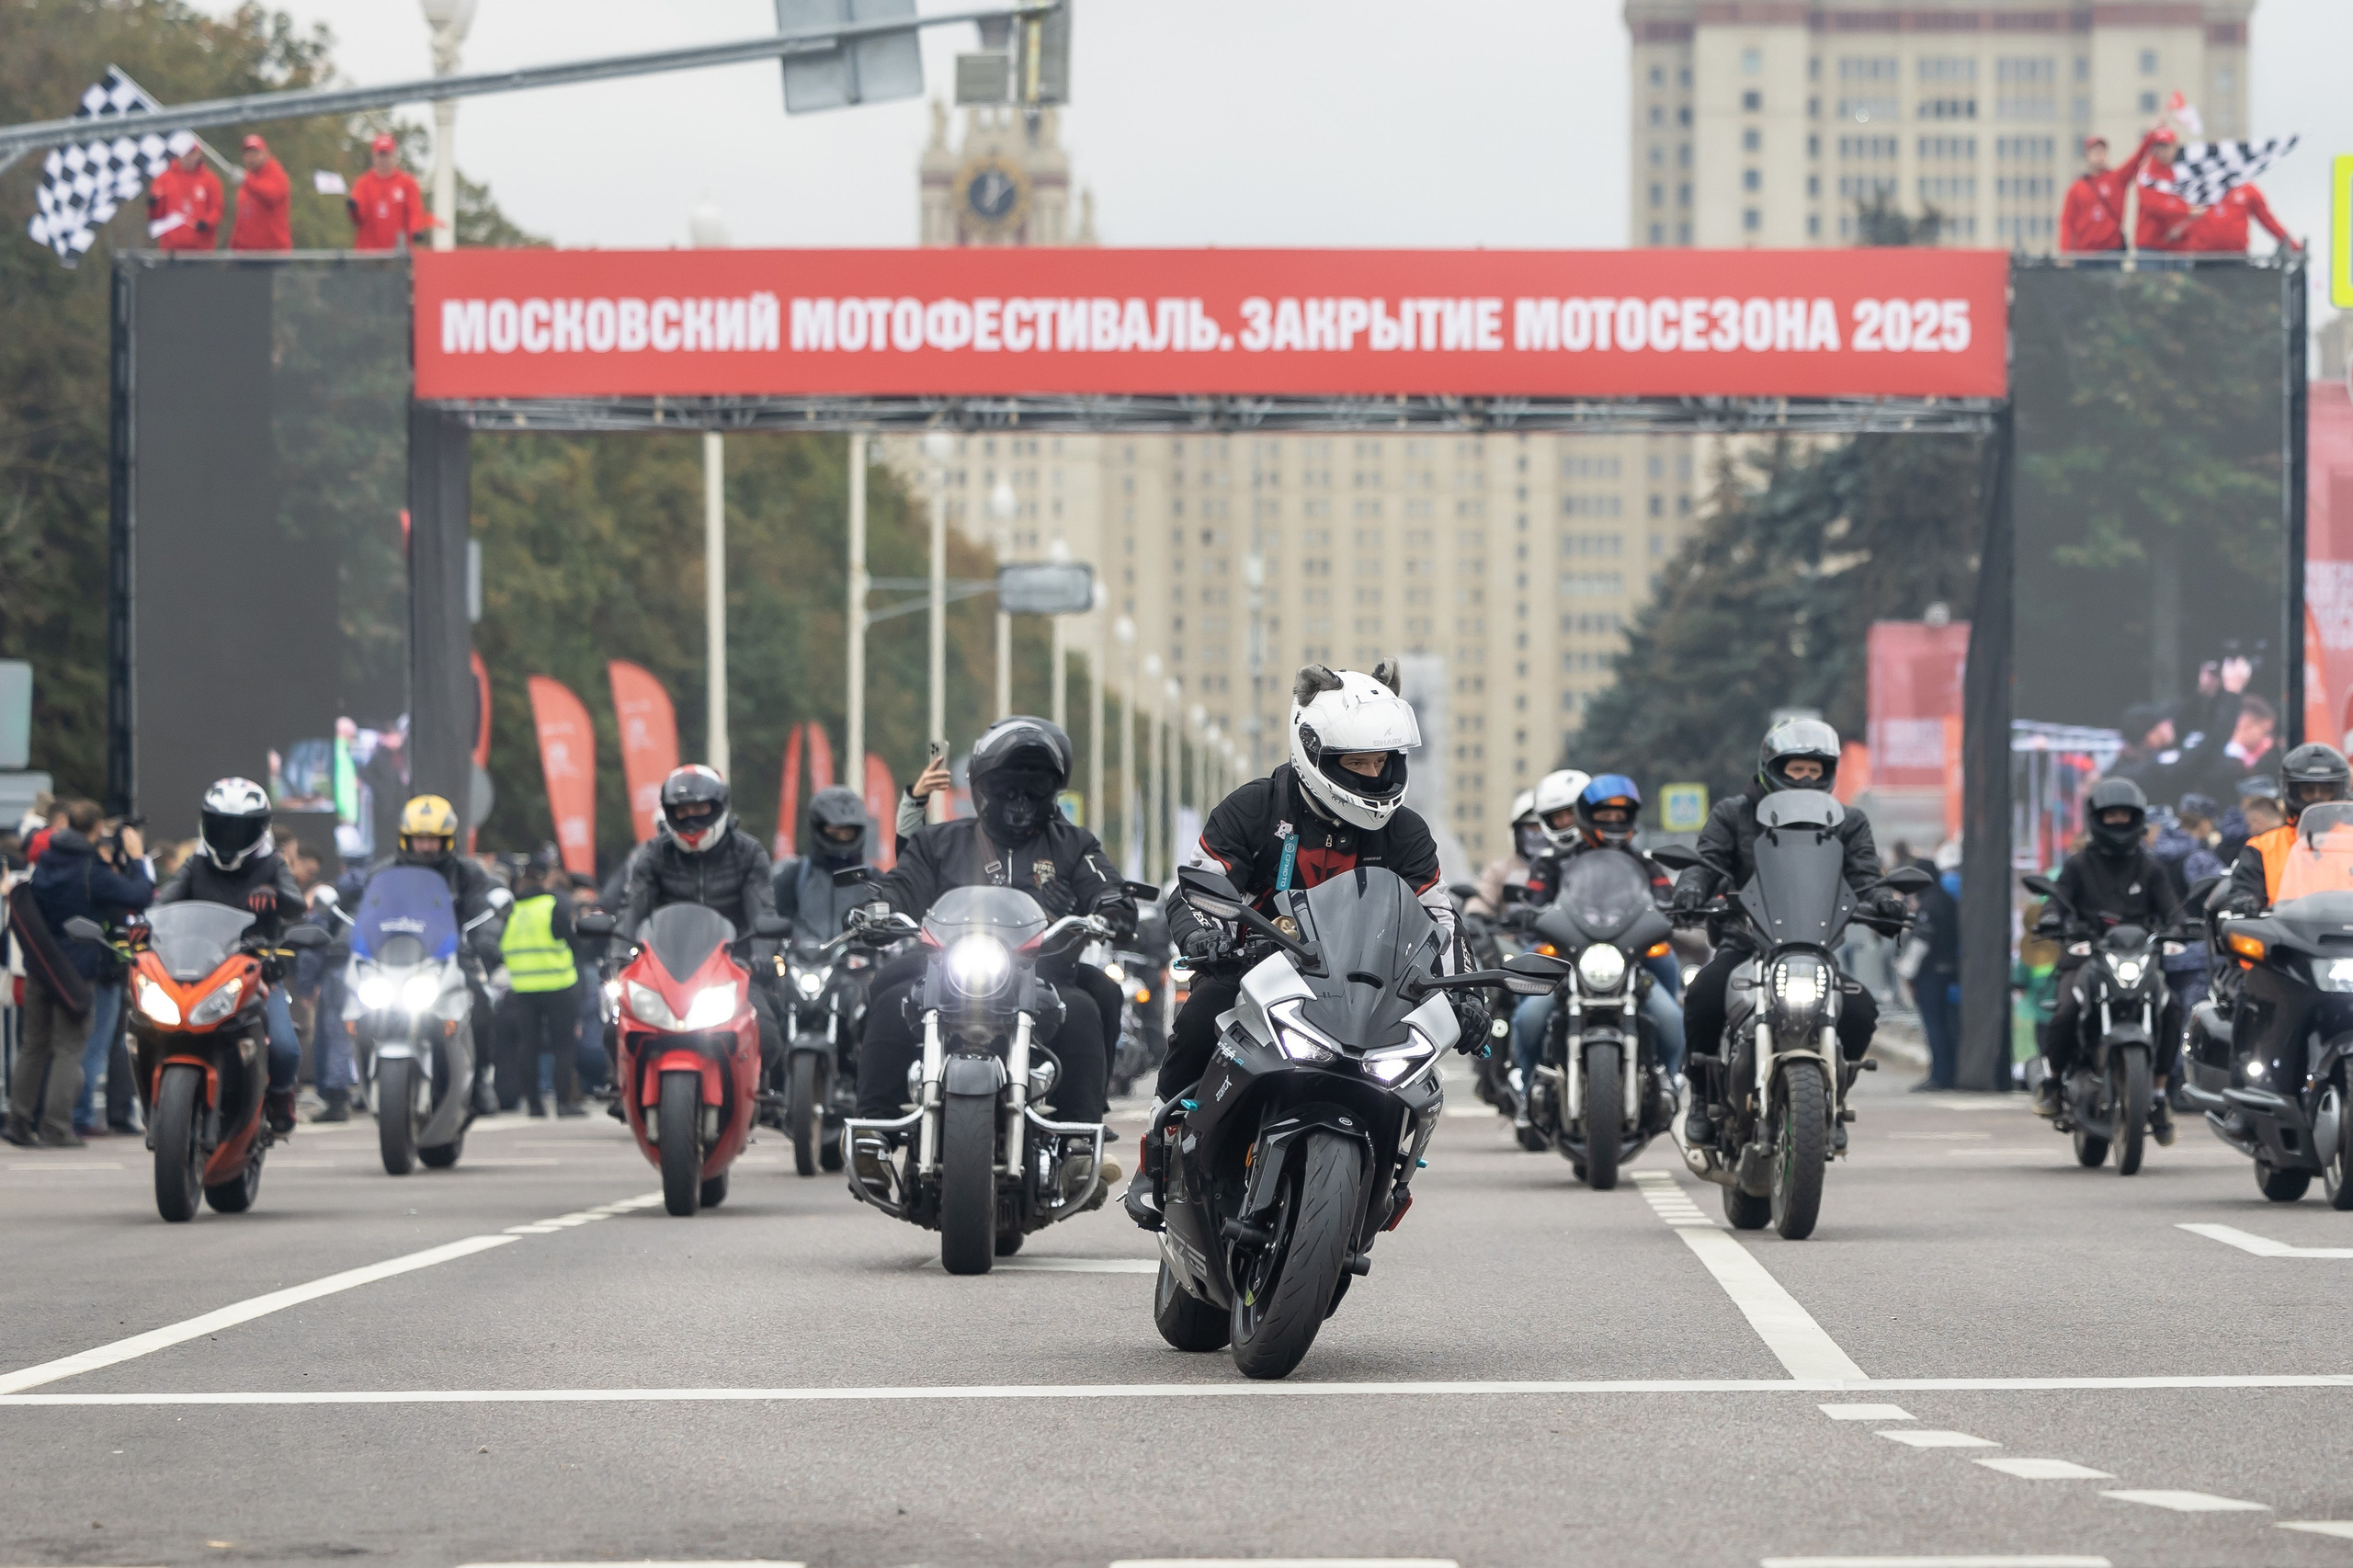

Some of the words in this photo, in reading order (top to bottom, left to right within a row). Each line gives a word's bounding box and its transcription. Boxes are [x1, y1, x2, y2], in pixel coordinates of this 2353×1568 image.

[441, 291, 780, 354] МОСКОВСКИЙ
[790, 297, 1234, 352] МОТОФЕСТИВАЛЬ.
[1239, 297, 1504, 352] ЗАКРЫТИЕ
[1513, 297, 1841, 352] МОТОСЕЗОНА
[1851, 297, 1972, 353] 2025
[1372, 737, 1404, 746] SHARK
[1280, 854, 1291, 888] CFMOTO
